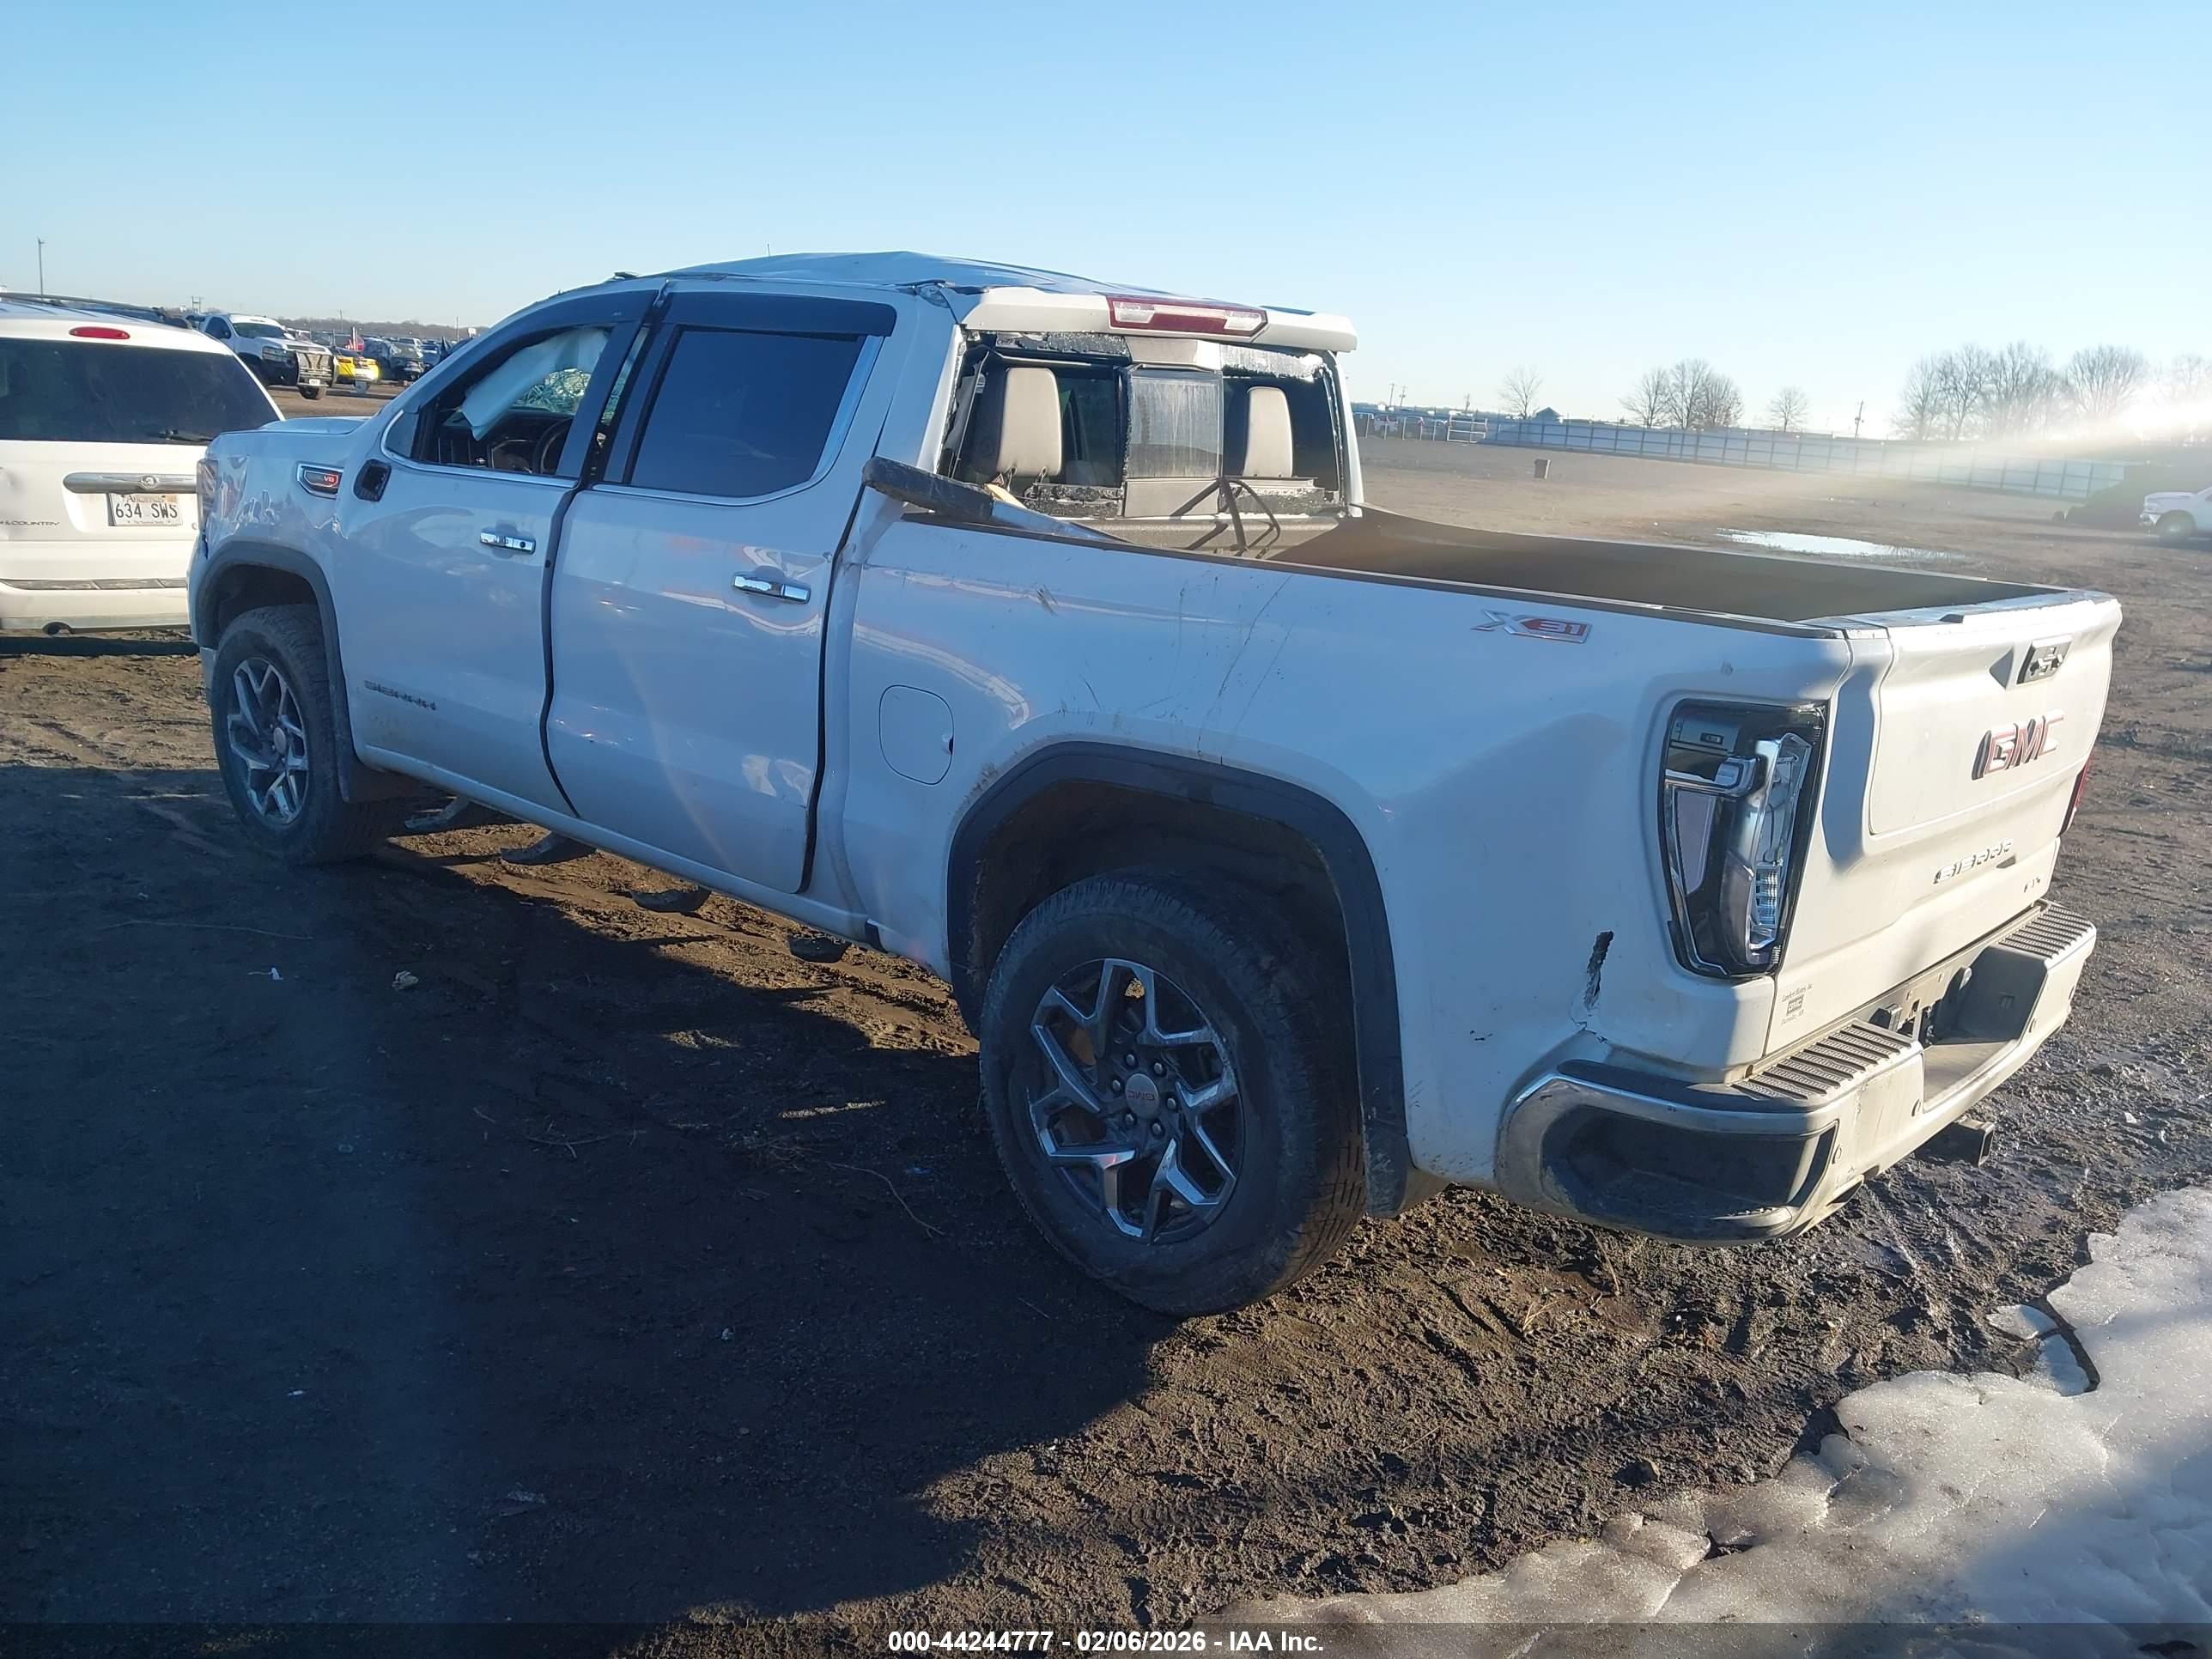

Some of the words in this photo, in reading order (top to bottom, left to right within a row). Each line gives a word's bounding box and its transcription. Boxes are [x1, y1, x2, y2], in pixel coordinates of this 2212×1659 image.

[323, 475, 336, 483] V8
[115, 502, 143, 518] 634
[150, 502, 179, 518] SWS
[1469, 609, 1593, 645] X31
[1971, 709, 2064, 781] GMC
